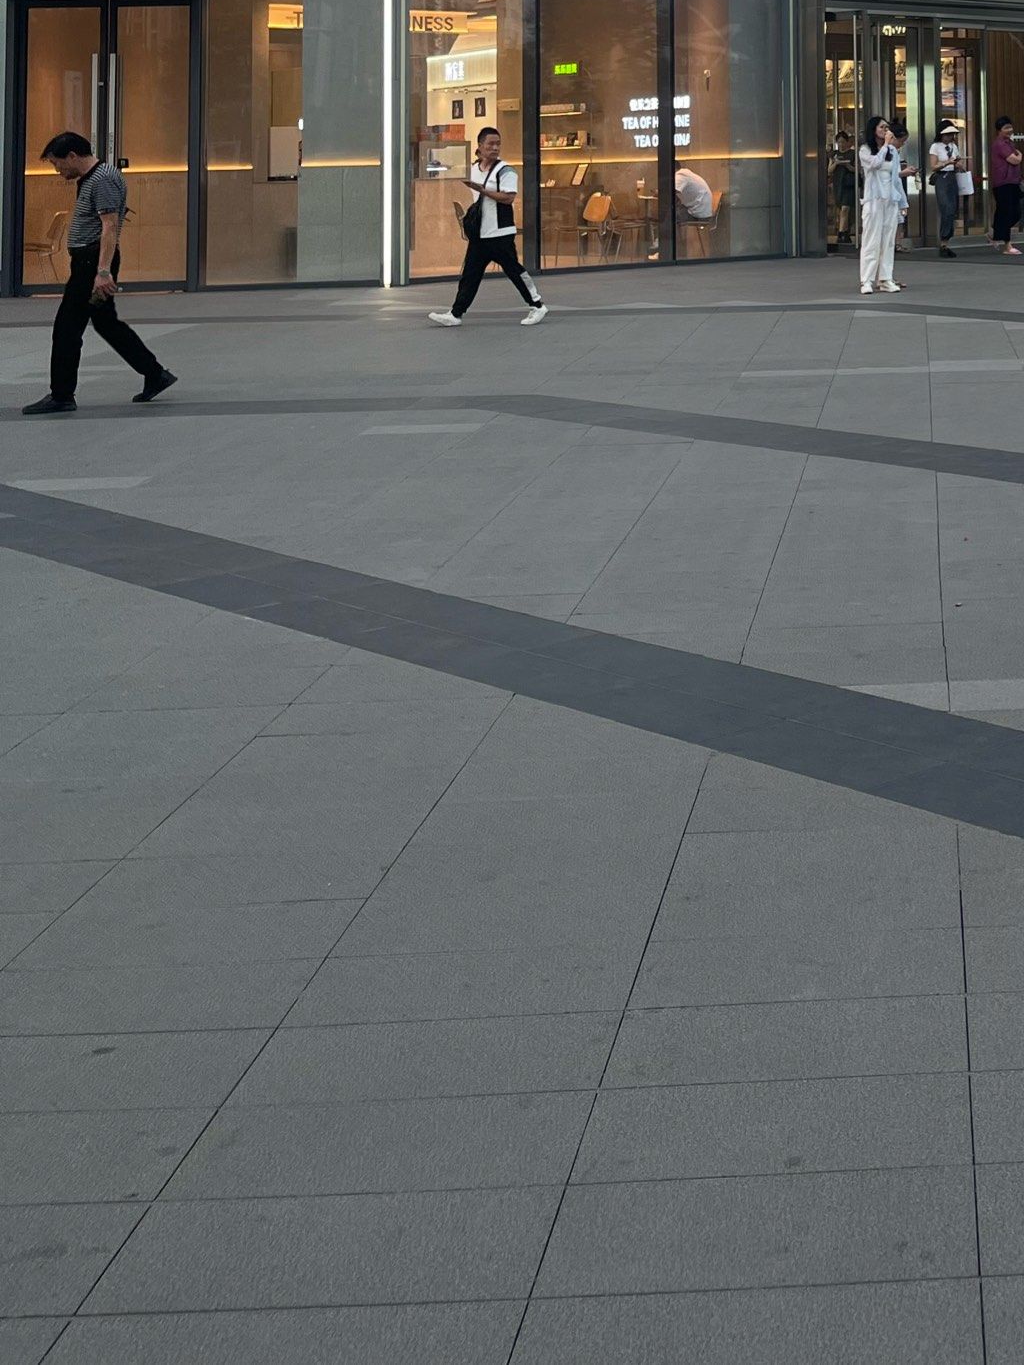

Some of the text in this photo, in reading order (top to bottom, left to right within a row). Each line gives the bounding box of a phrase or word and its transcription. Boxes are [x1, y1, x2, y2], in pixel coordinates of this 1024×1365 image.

[622, 116, 639, 129] TEA
[640, 116, 652, 129] OF
[634, 135, 651, 147] TEA
